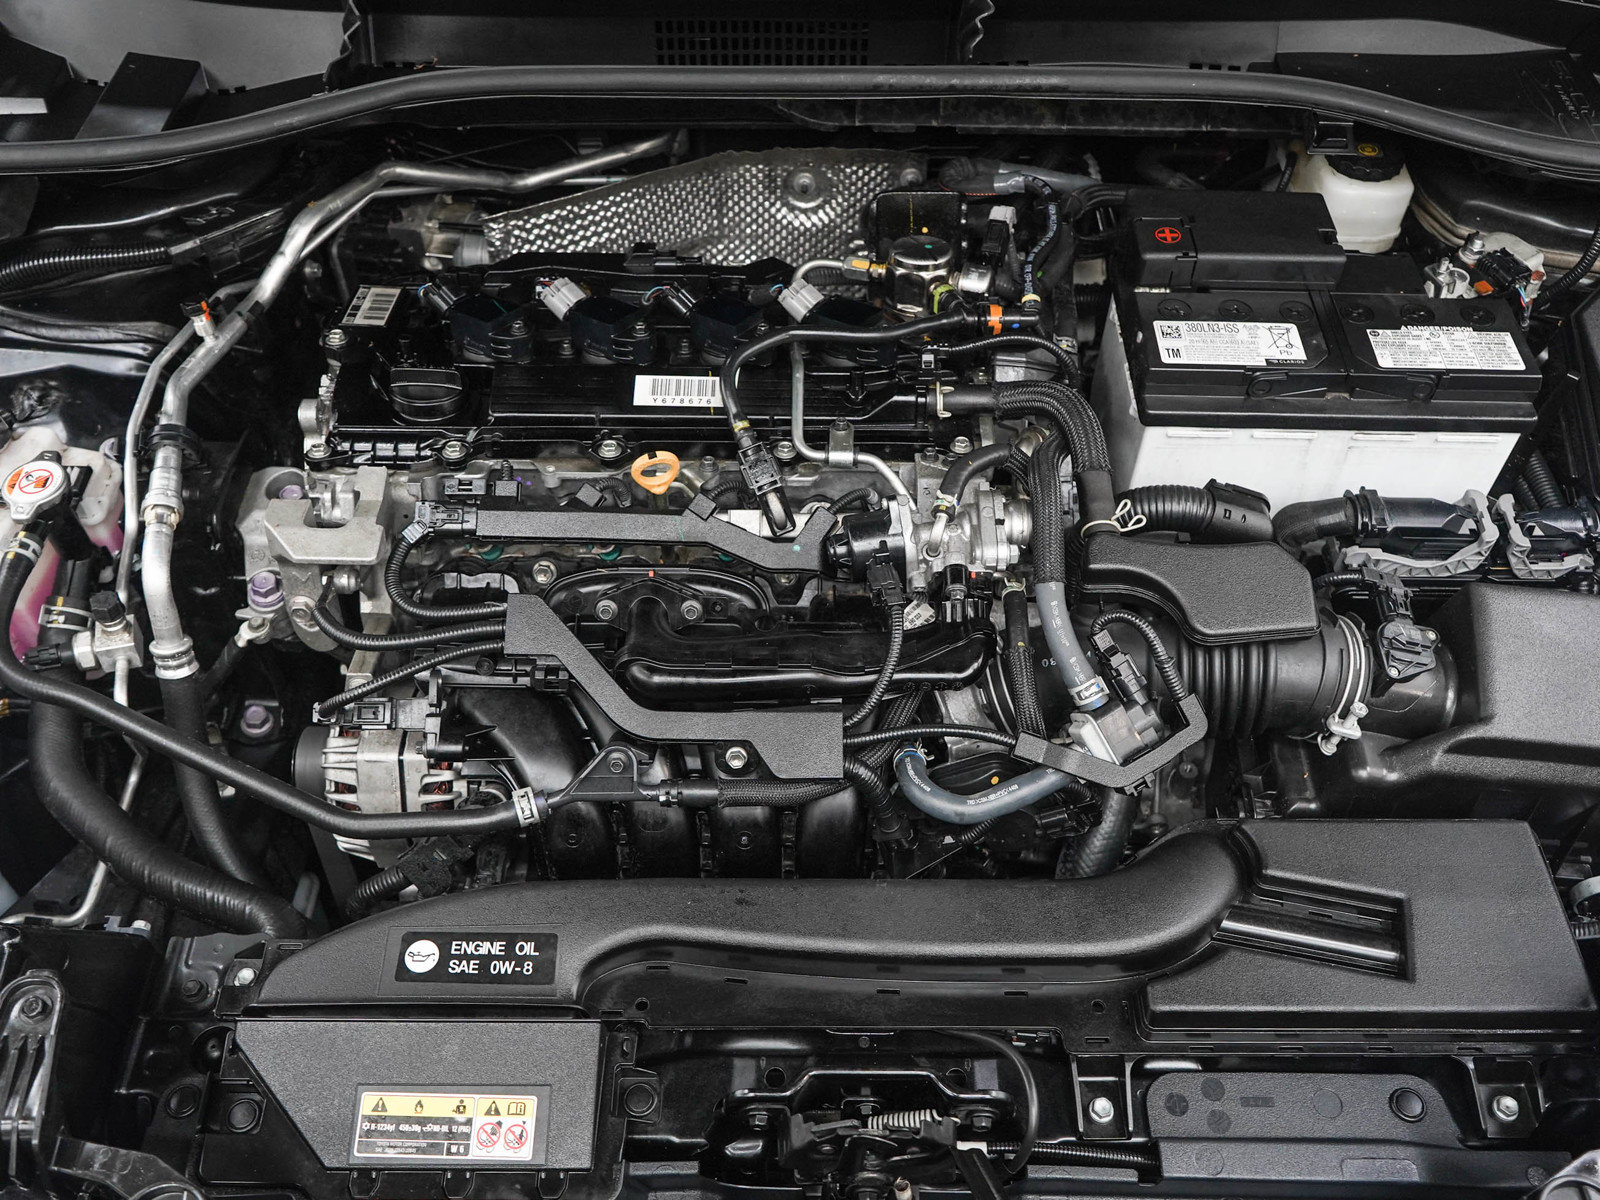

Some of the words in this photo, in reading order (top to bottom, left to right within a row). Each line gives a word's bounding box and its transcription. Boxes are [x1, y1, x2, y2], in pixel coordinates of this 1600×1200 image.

[1185, 322, 1240, 334] 380LN3-ISS
[1165, 347, 1182, 359] TM
[450, 940, 507, 955] ENGINE
[515, 941, 540, 956] OIL
[448, 959, 480, 974] SAE
[489, 960, 534, 975] 0W-8
